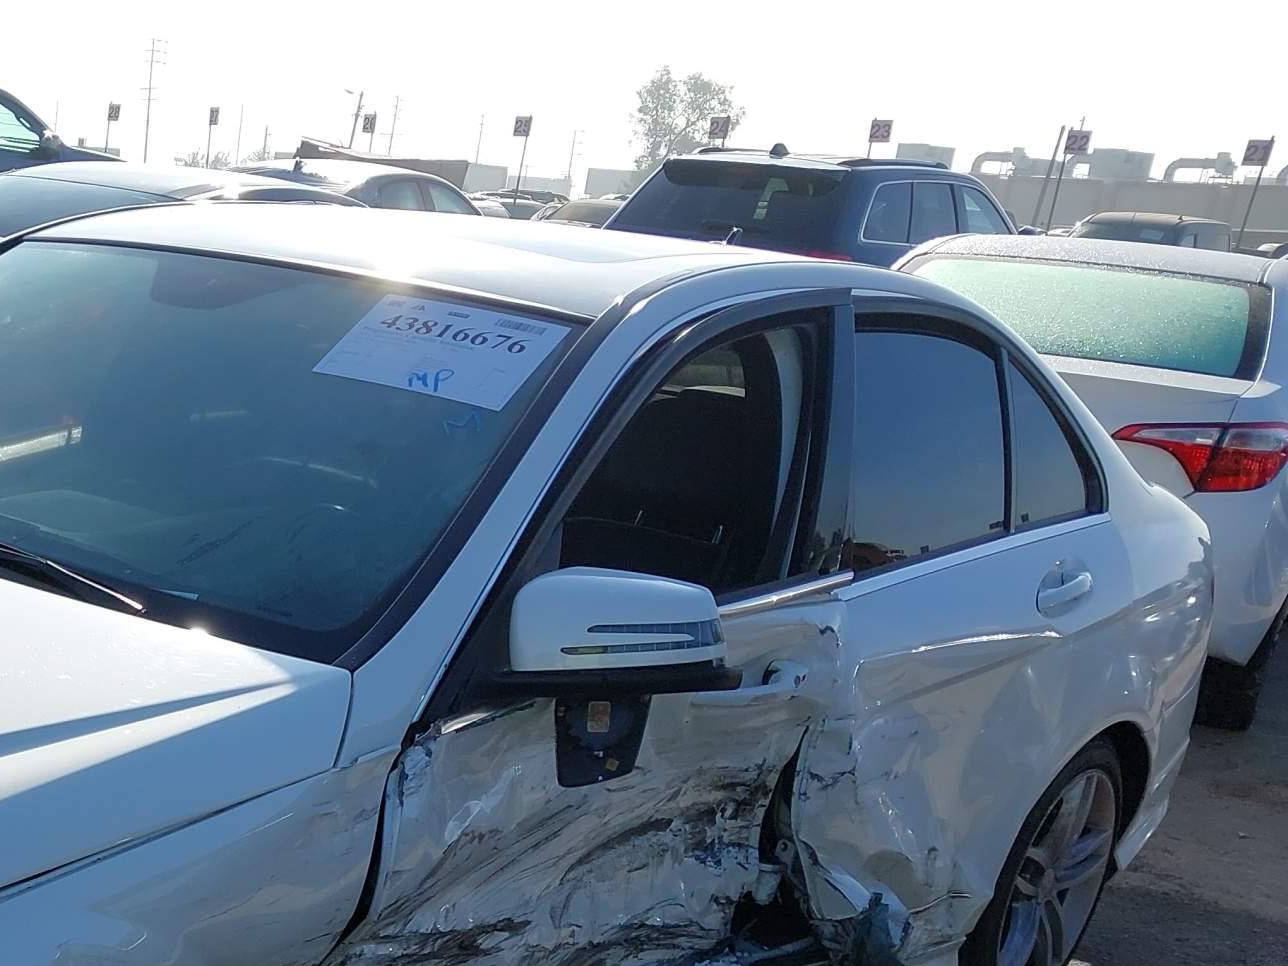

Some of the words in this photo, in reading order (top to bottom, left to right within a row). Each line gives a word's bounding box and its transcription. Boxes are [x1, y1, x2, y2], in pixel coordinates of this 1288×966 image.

[108, 106, 120, 118] 28
[710, 121, 726, 135] 24
[871, 124, 891, 138] 23
[1066, 135, 1089, 150] 22
[380, 315, 532, 354] 43816676
